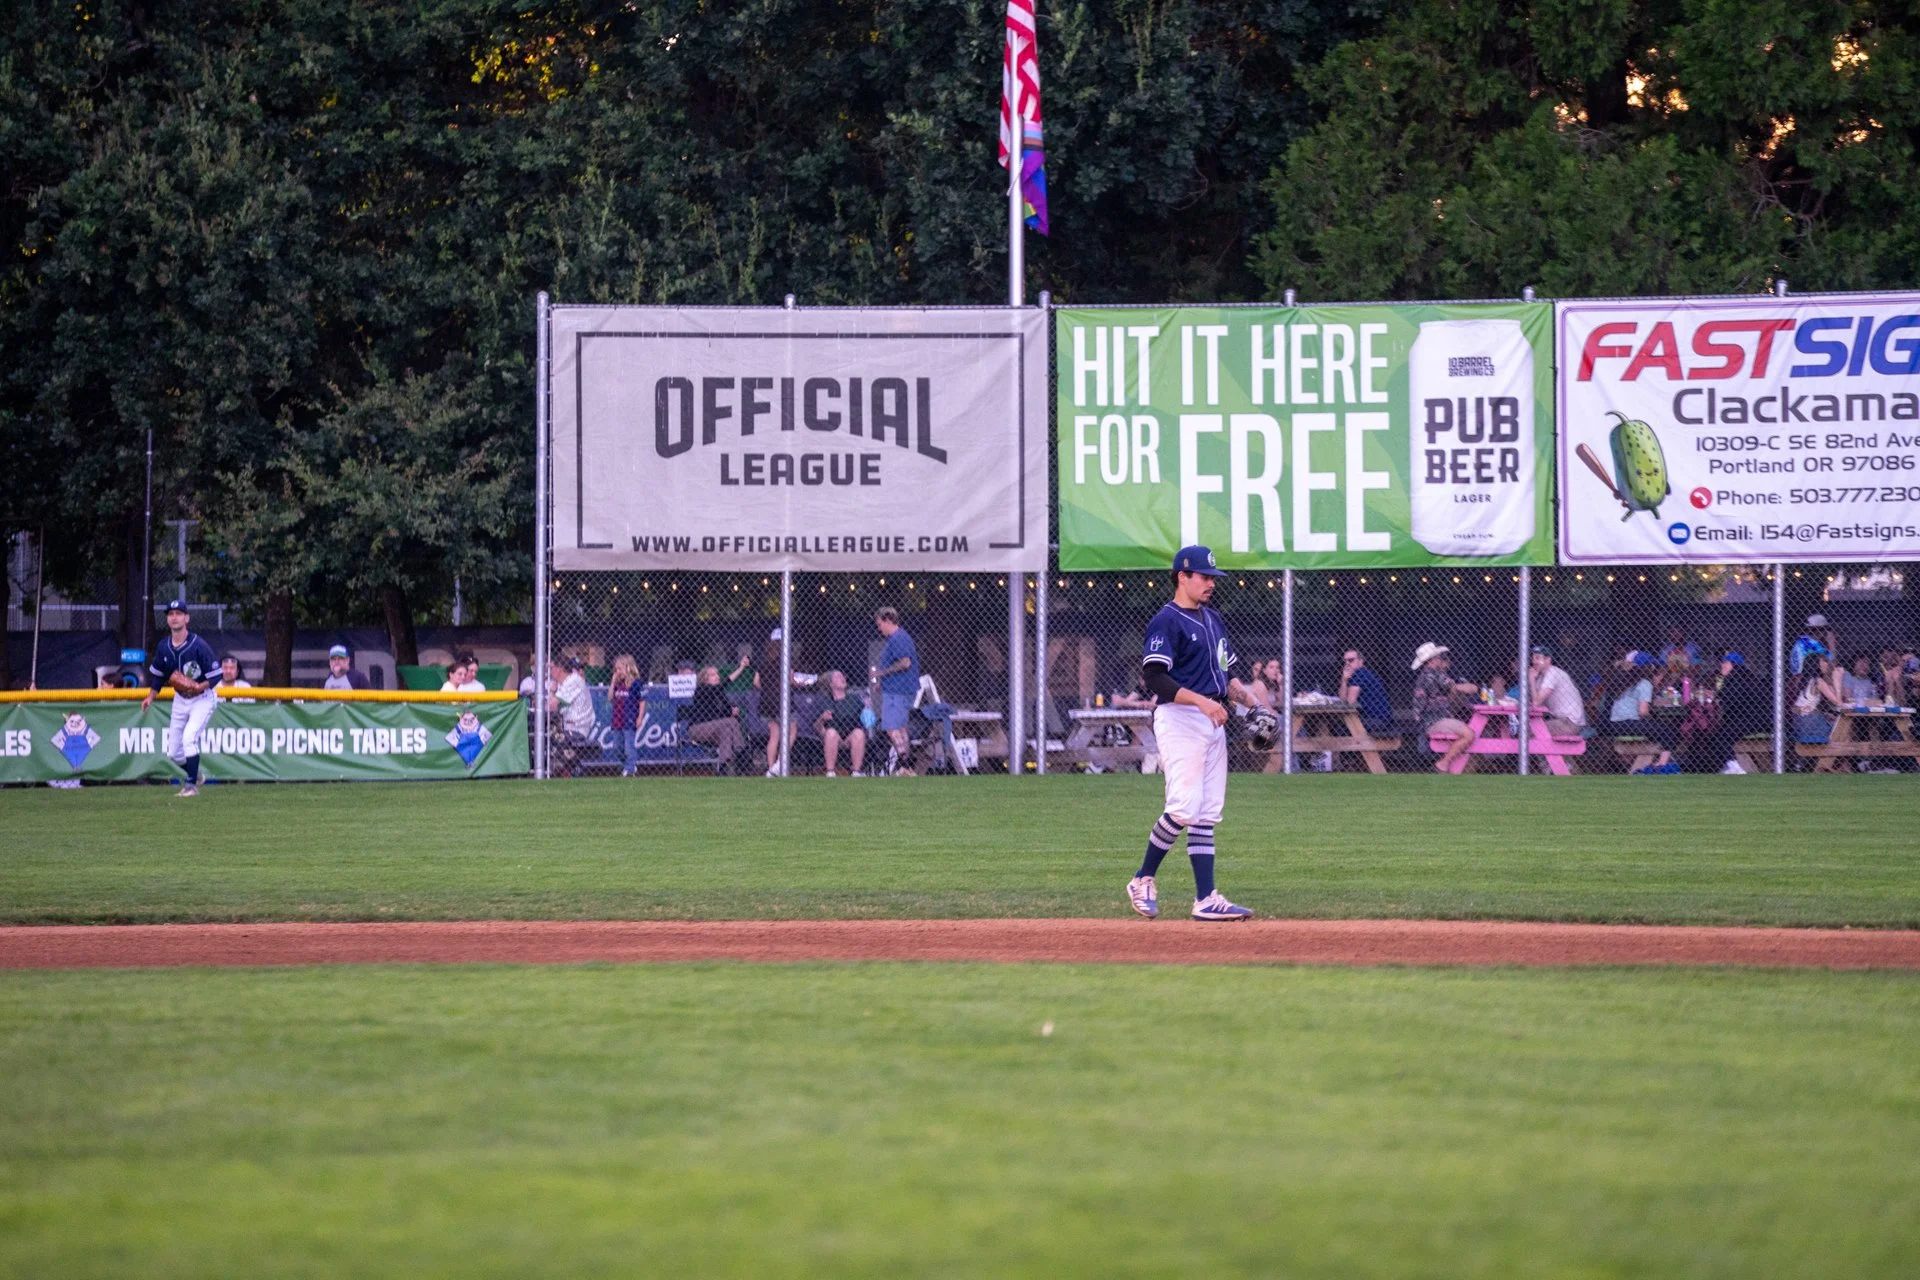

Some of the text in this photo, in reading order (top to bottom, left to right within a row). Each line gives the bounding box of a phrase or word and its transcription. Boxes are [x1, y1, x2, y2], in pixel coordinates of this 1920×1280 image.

[1458, 356, 1495, 368] BARREL
[1576, 315, 1920, 382] FASTSIG
[1073, 322, 1389, 407] HIT IT HERE
[1448, 367, 1484, 377] BREWING
[1672, 386, 1920, 425] Clackama
[655, 376, 948, 465] OFFICIAL
[1424, 397, 1520, 444] PUB
[1696, 435, 1781, 452] 10309-C
[1789, 435, 1817, 451] SE
[1825, 433, 1878, 449] 82nd
[720, 453, 881, 486] LEAGUE
[1424, 448, 1520, 485] BEER
[1709, 455, 1915, 474] Portland OR 97086
[1074, 411, 1391, 553] FOR FREE
[1454, 493, 1493, 504] LAGER
[1716, 490, 1783, 506] Phone:
[632, 535, 970, 553] WWW.OFFICIALLEAGUE.COM
[1695, 526, 1753, 542] Email:
[119, 727, 427, 755] MR WOOD PICNIC TABLES
